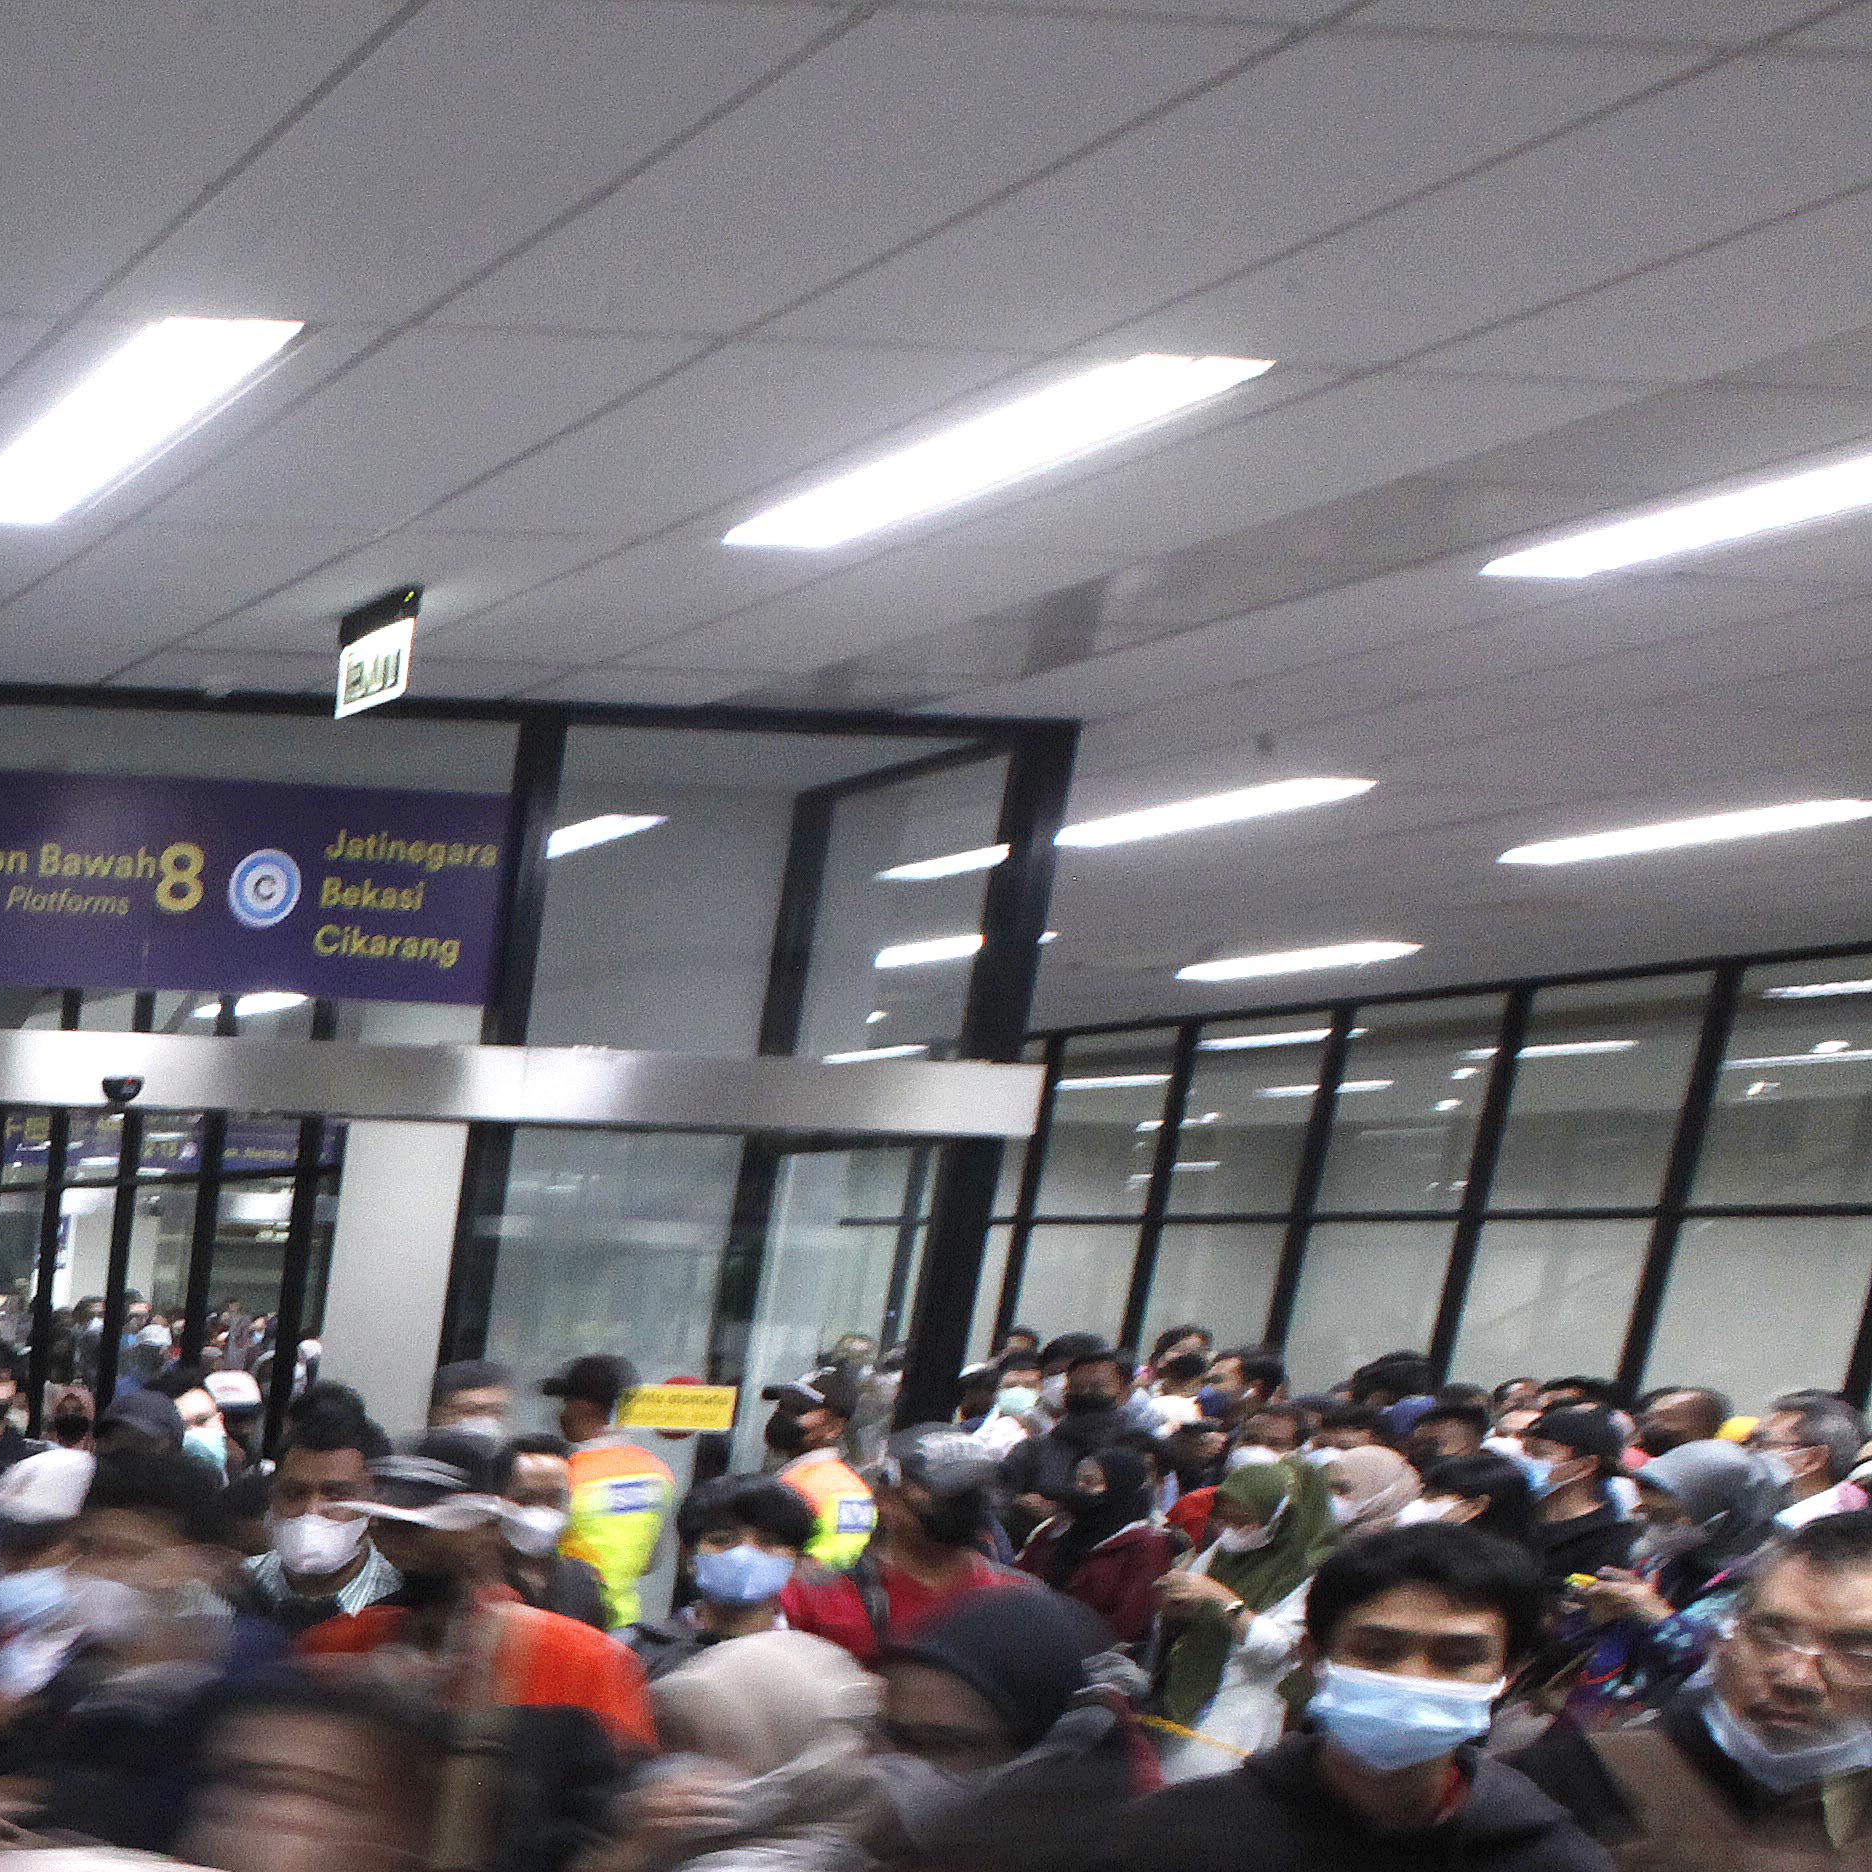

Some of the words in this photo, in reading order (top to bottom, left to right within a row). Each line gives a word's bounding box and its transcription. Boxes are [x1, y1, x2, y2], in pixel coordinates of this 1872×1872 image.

[39, 842, 155, 880] Bawah
[324, 829, 499, 872] Jatinegara
[156, 842, 204, 914] 8
[320, 876, 425, 911] Bekasi
[7, 884, 129, 916] Platforms
[312, 923, 461, 969] Cikarang
